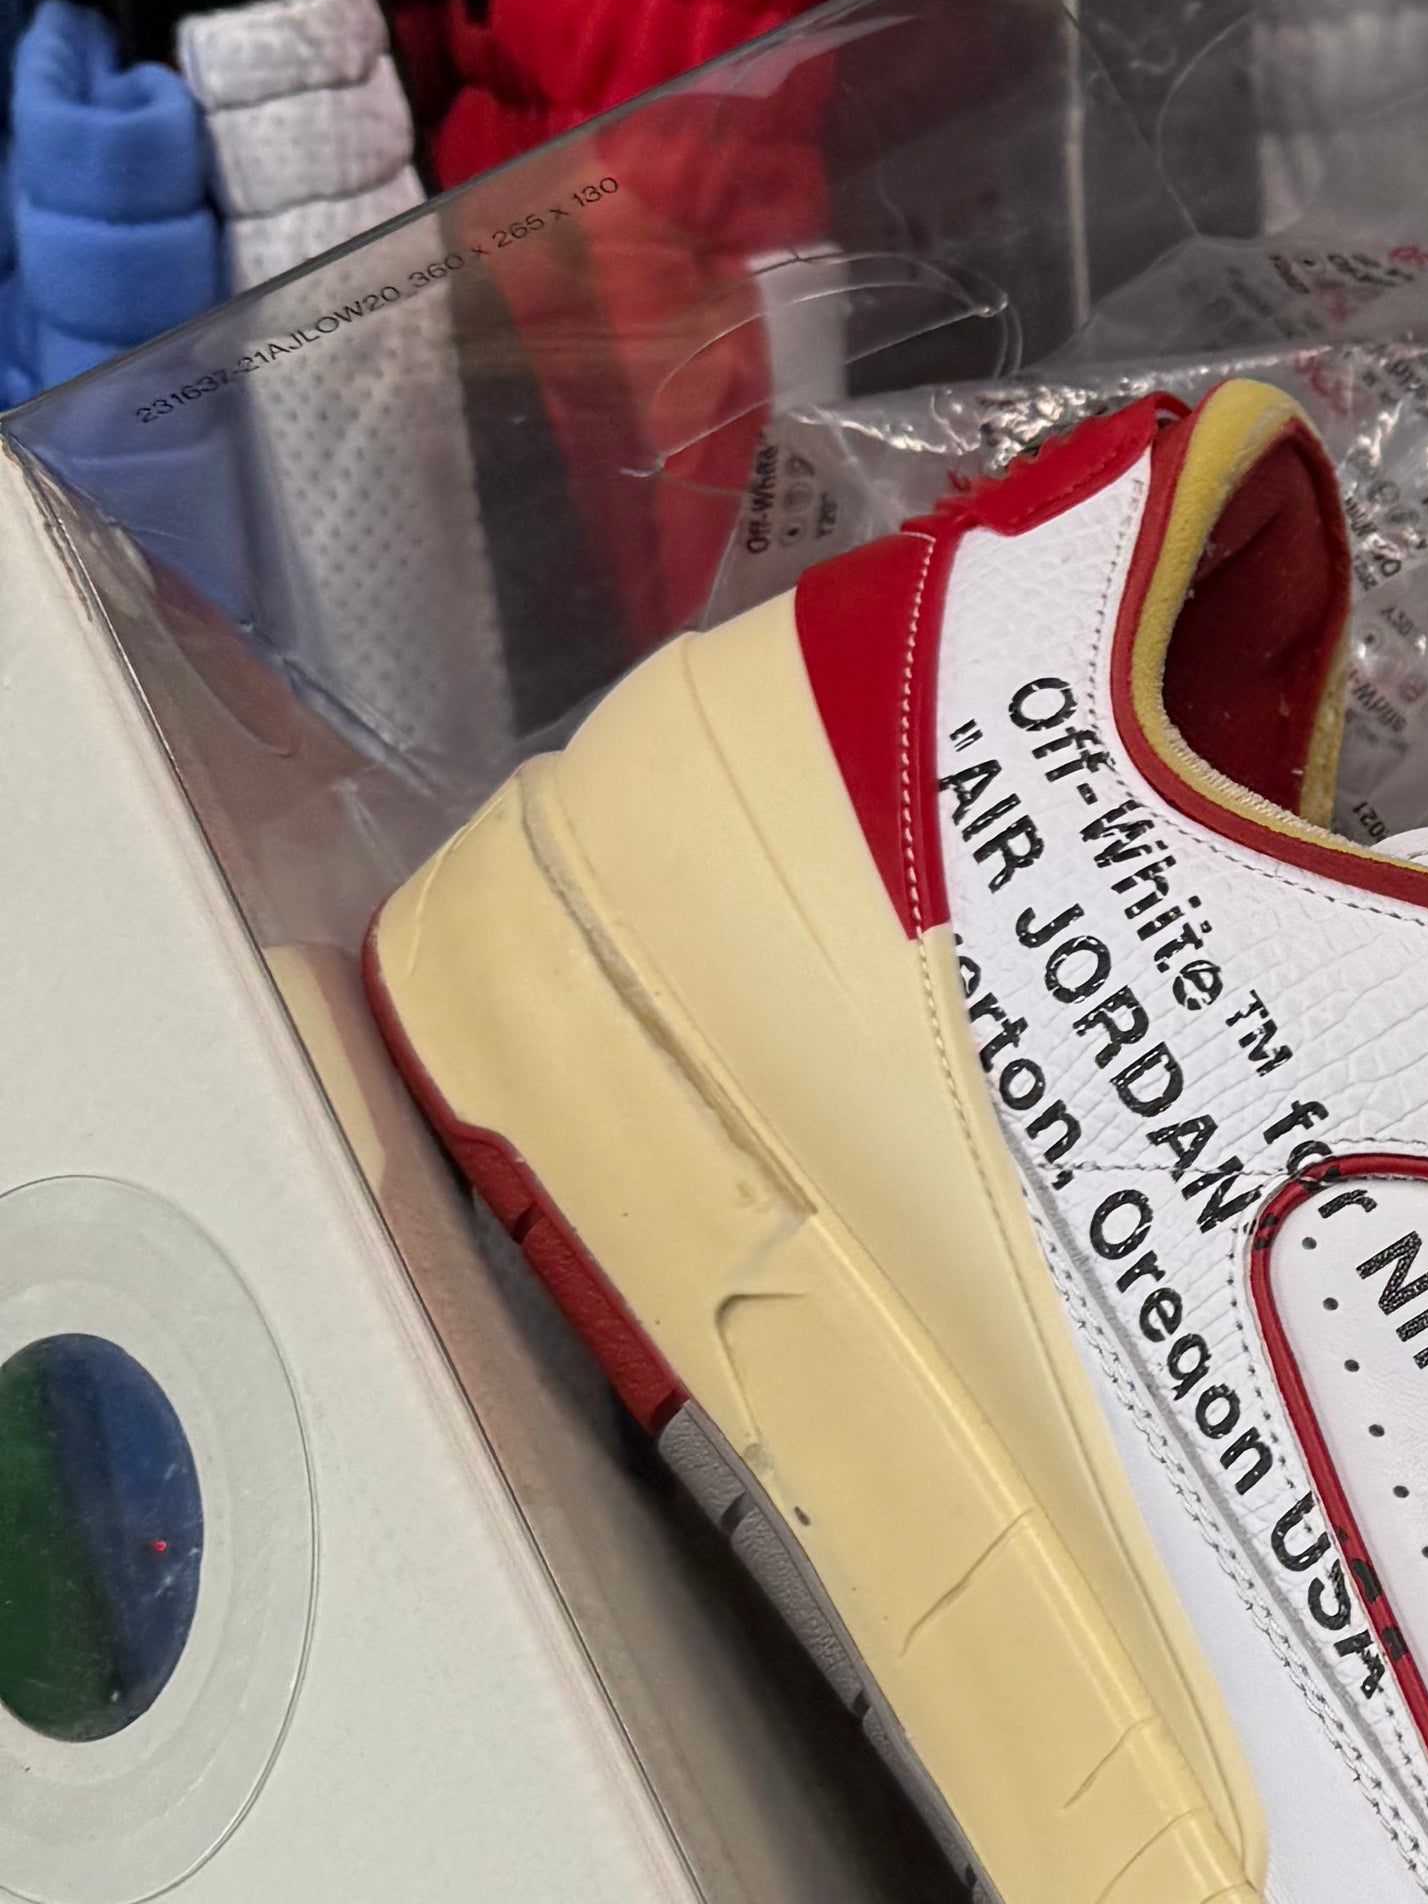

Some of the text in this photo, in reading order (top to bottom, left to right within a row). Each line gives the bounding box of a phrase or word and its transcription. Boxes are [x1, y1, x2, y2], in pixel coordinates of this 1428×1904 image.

[470, 242, 489, 260] x
[491, 213, 547, 252] 265
[549, 204, 569, 221] x
[572, 175, 620, 217] 130
[937, 718, 1046, 895] "AIR
[1351, 799, 1392, 843] 021
[952, 930, 1084, 1192] erton,
